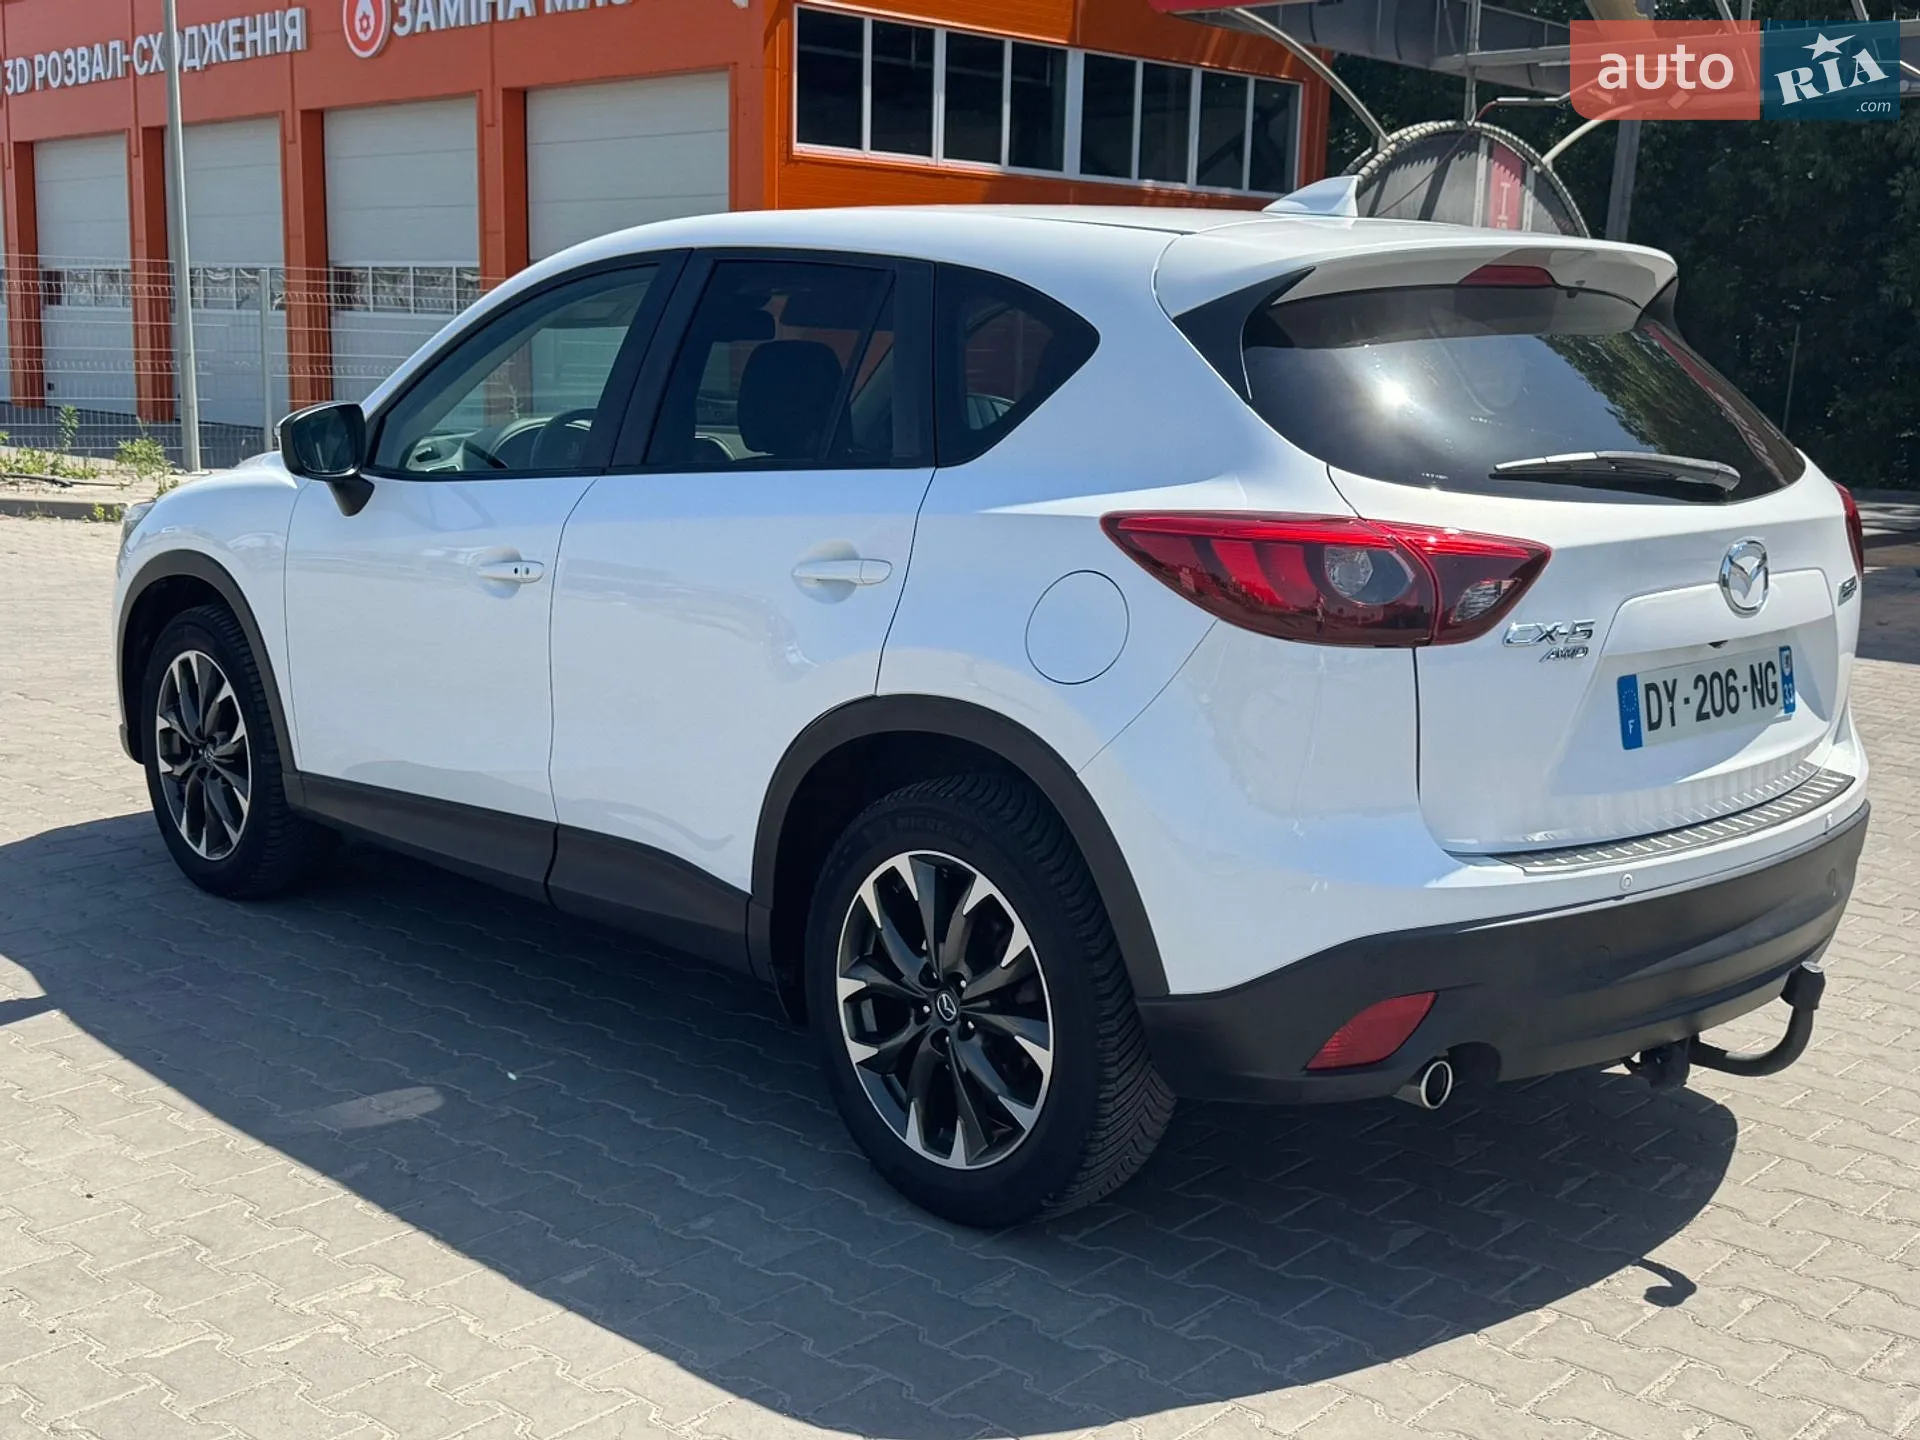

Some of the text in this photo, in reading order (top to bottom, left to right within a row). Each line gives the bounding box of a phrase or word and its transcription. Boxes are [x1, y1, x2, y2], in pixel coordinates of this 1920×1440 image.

[4, 8, 305, 95] 3D РОЗВАЛ-СХДЖЕННЯ
[1503, 620, 1595, 647] CX-5
[1539, 646, 1589, 662] AWD
[1644, 661, 1778, 732] DY-206-NG
[1627, 719, 1636, 735] F
